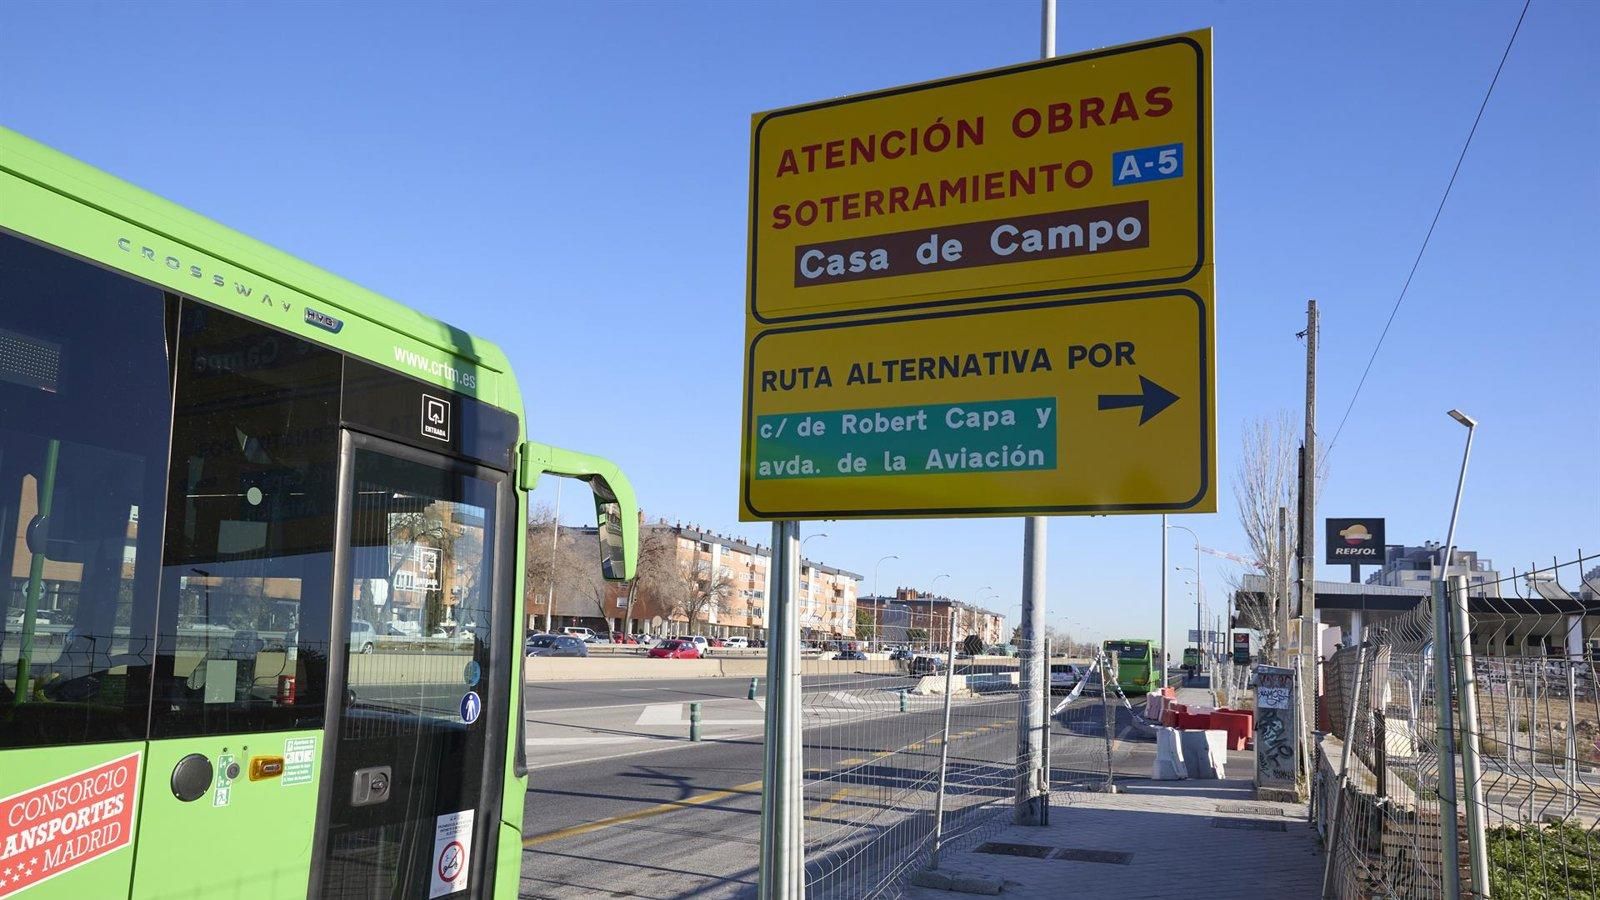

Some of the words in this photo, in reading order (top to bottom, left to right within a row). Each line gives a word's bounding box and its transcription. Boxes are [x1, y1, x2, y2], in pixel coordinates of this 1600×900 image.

[776, 116, 984, 178] ATENCIÓN
[1012, 86, 1173, 138] OBRAS
[772, 160, 1093, 230] SOTERRAMIENTO
[1118, 149, 1178, 180] A-5
[800, 248, 889, 279] Casa
[916, 234, 963, 265] de
[990, 216, 1142, 256] Campo
[118, 237, 291, 313] CROSSWAY
[394, 345, 476, 389] www.crtm.es
[761, 365, 833, 392] RUTA
[846, 348, 1052, 386] ALTERNATIVA
[1068, 341, 1136, 370] POR
[424, 425, 446, 437] ENTRADA
[760, 417, 787, 439] c/
[797, 416, 826, 437] de
[841, 409, 928, 435] Robert
[945, 407, 1016, 431] Capa
[1036, 407, 1052, 429] y
[759, 455, 821, 476] avda.
[837, 453, 867, 473] de
[883, 451, 907, 472] la
[925, 444, 1045, 470] Aviación
[1335, 547, 1377, 555] REPSOL
[8, 766, 128, 827] CONSORCIO
[0, 793, 125, 861] ANSPORTES
[42, 821, 121, 872] MADRID
